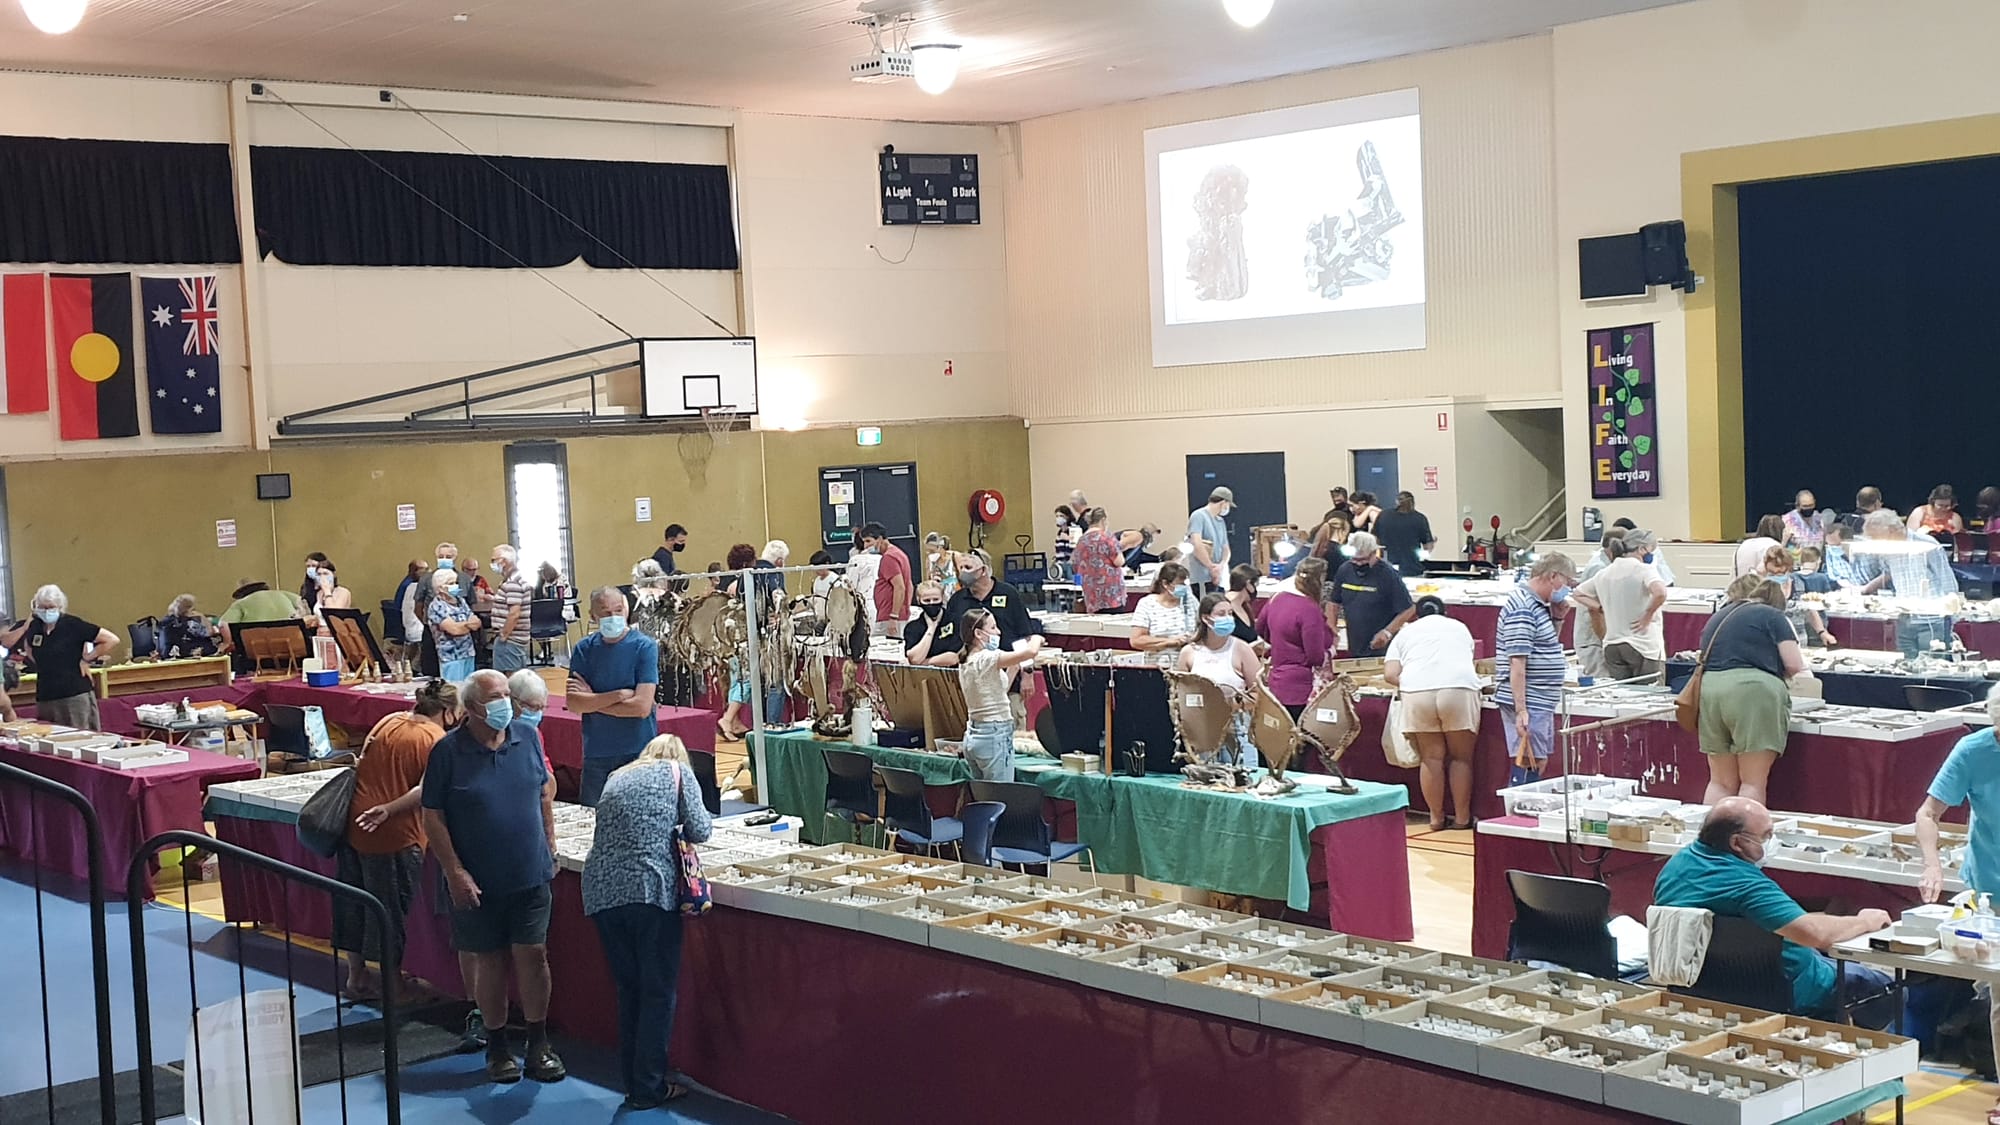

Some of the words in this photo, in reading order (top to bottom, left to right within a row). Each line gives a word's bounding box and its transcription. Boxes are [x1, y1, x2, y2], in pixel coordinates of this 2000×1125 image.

[885, 187, 891, 197] A
[893, 187, 911, 199] Light
[952, 187, 958, 197] B
[960, 187, 976, 197] Dark
[1593, 345, 1633, 367] Living
[1598, 384, 1614, 407] In
[1595, 423, 1628, 445] Faith
[1597, 458, 1650, 483] Everyday
